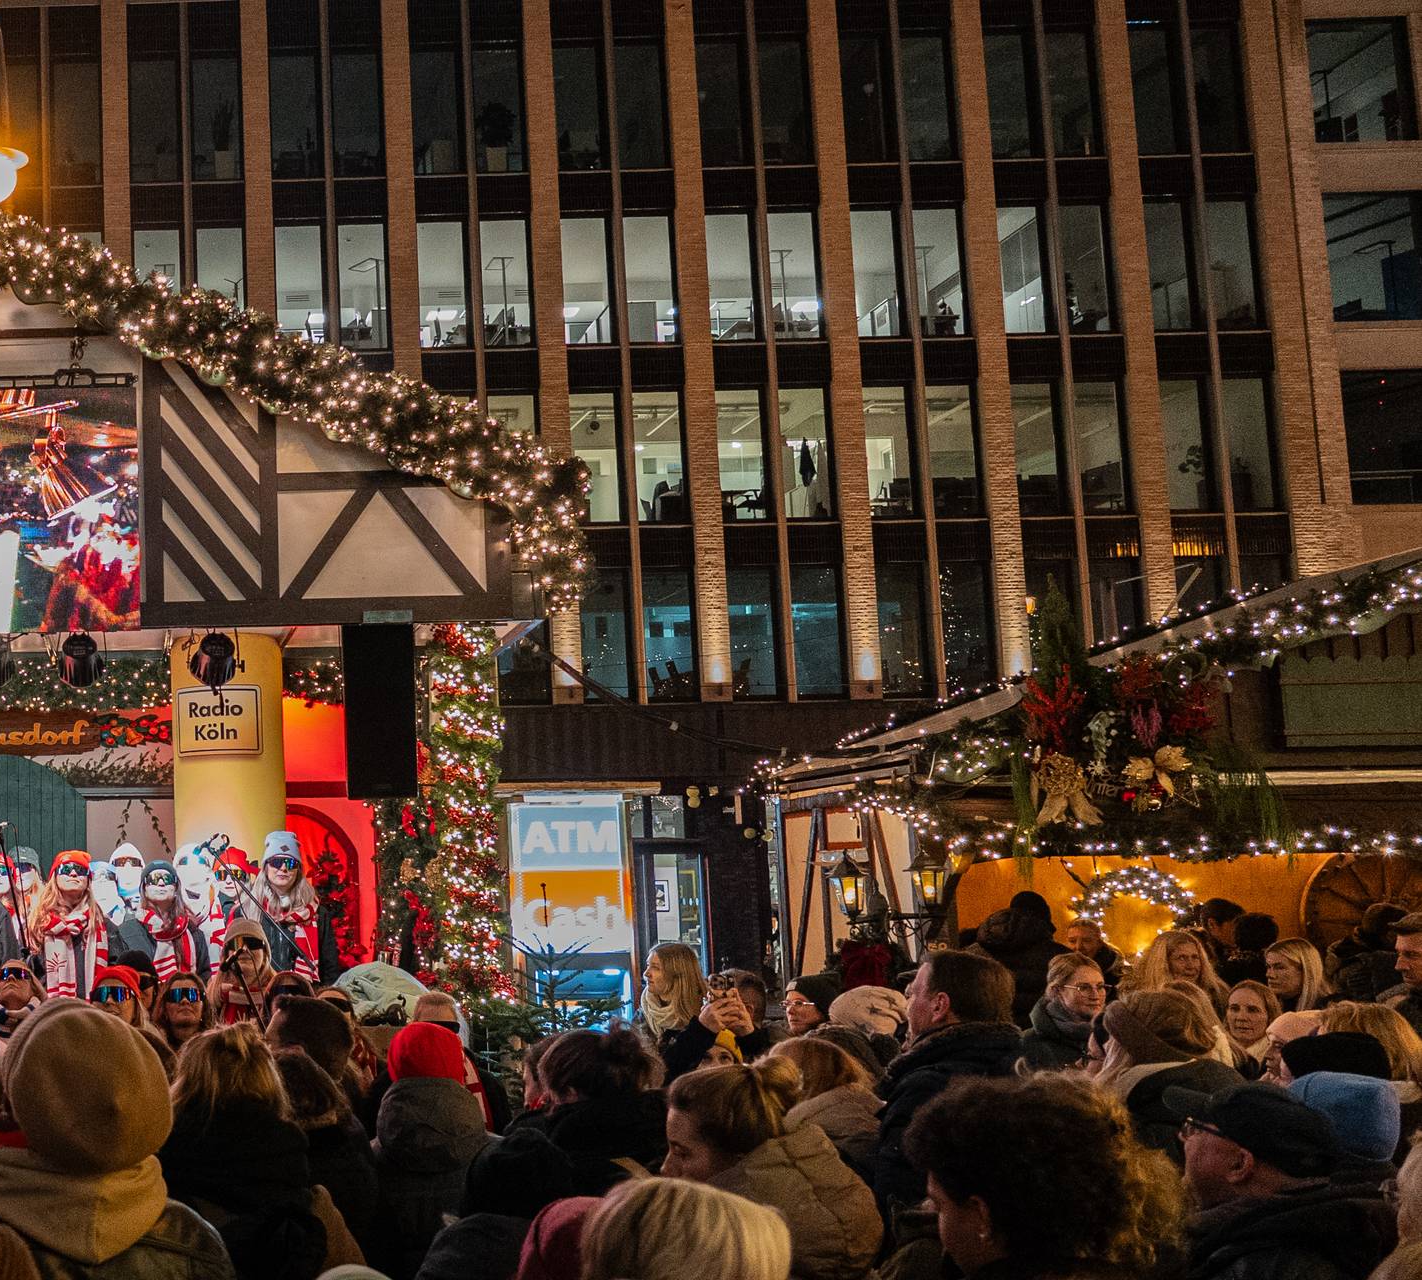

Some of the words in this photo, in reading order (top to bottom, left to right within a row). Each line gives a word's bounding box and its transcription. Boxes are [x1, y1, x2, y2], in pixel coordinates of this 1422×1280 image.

[188, 698, 244, 718] Radio
[194, 722, 238, 741] Köln
[522, 820, 618, 853] ATM
